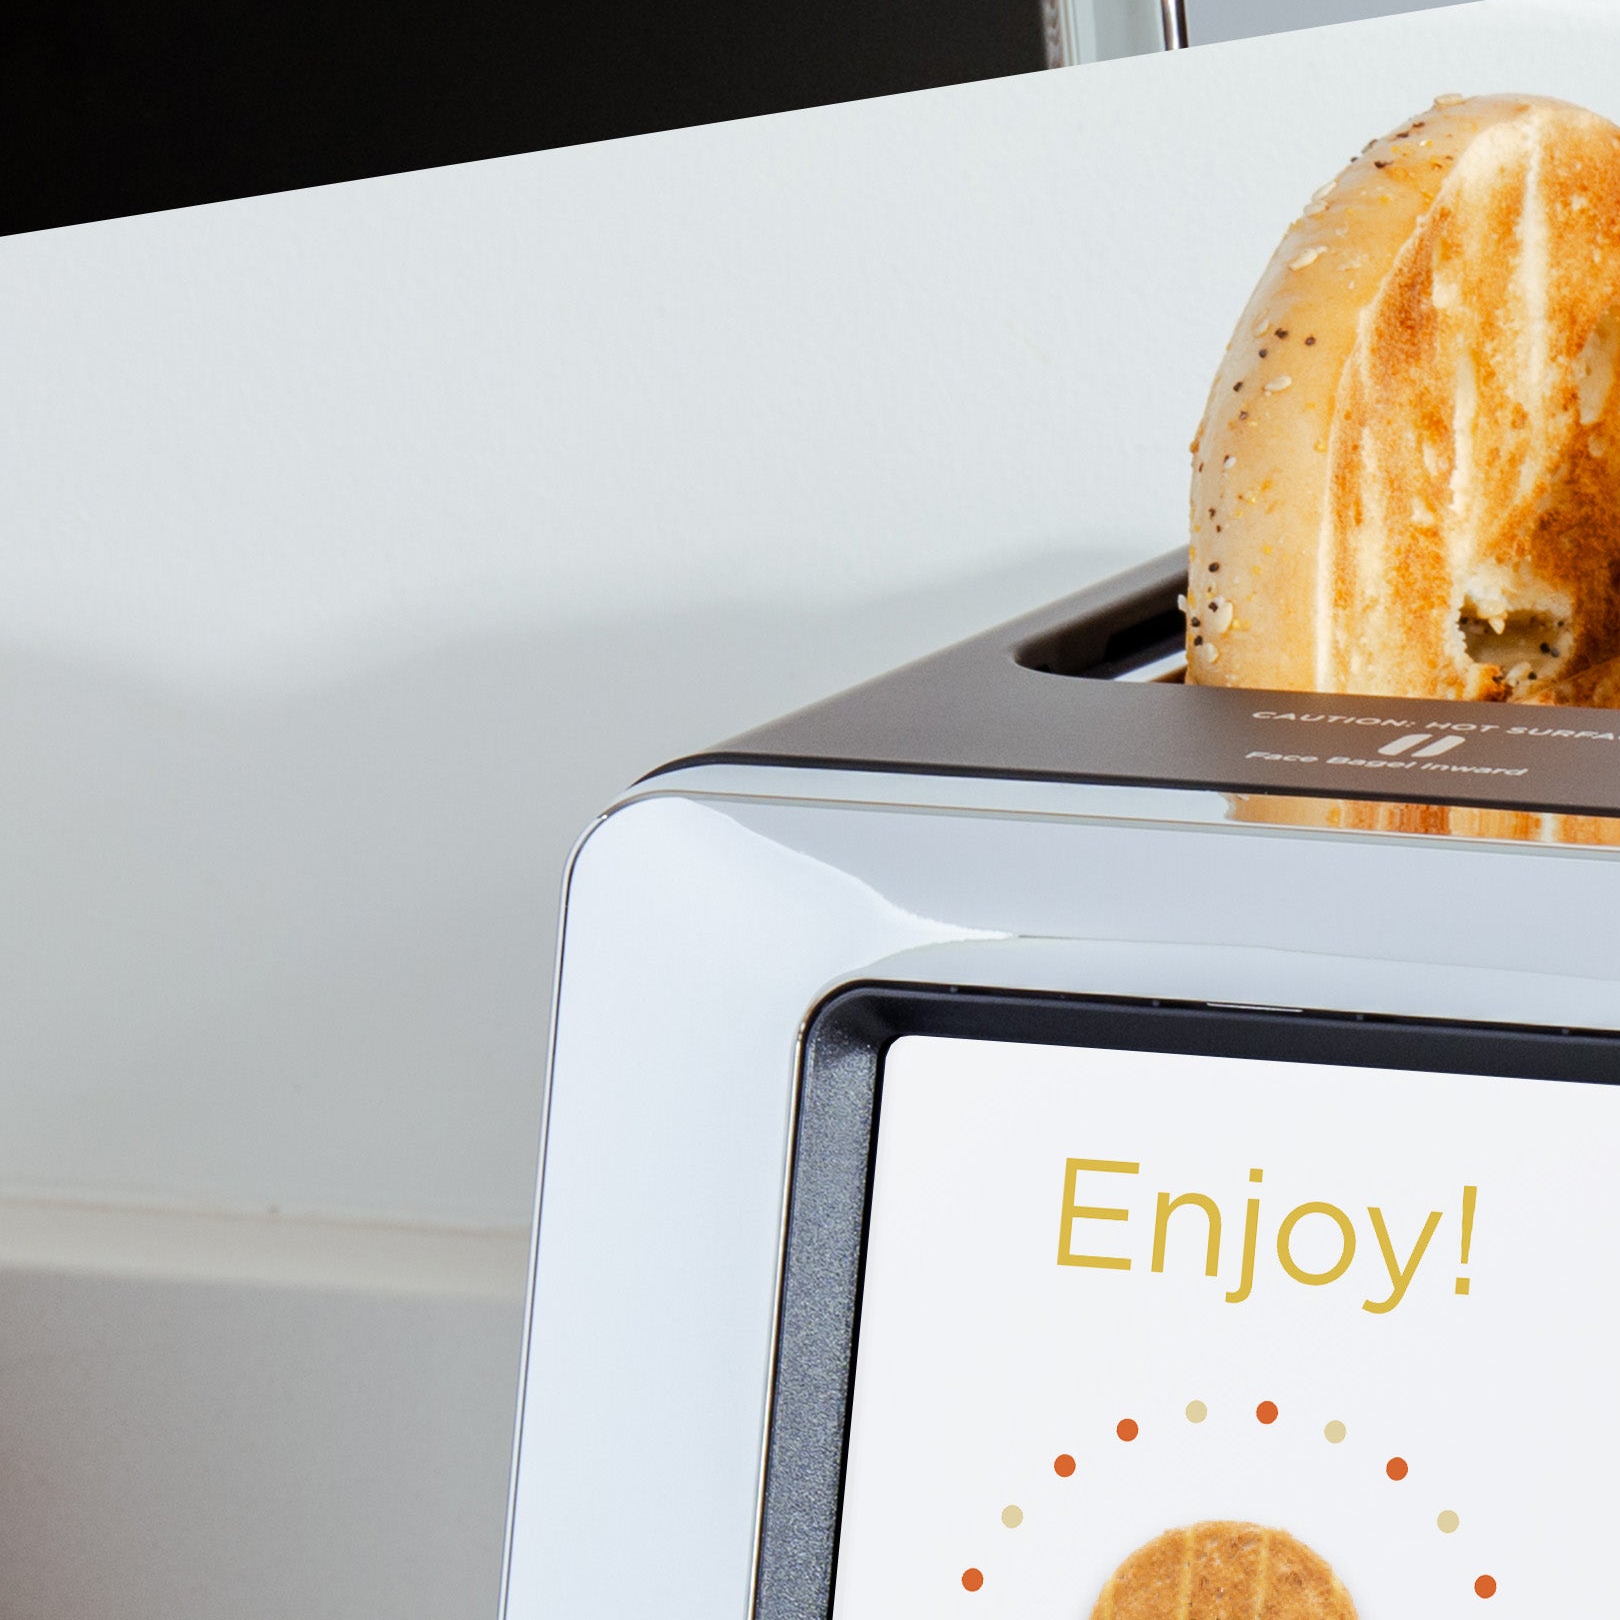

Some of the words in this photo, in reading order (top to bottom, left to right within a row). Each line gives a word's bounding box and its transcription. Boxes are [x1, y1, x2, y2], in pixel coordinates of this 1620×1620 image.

[1252, 711, 1416, 728] CAUTION:
[1425, 721, 1499, 733] HOT
[1245, 751, 1318, 762] Face
[1326, 755, 1417, 769] Bagel
[1057, 1158, 1478, 1314] Enjoy!
